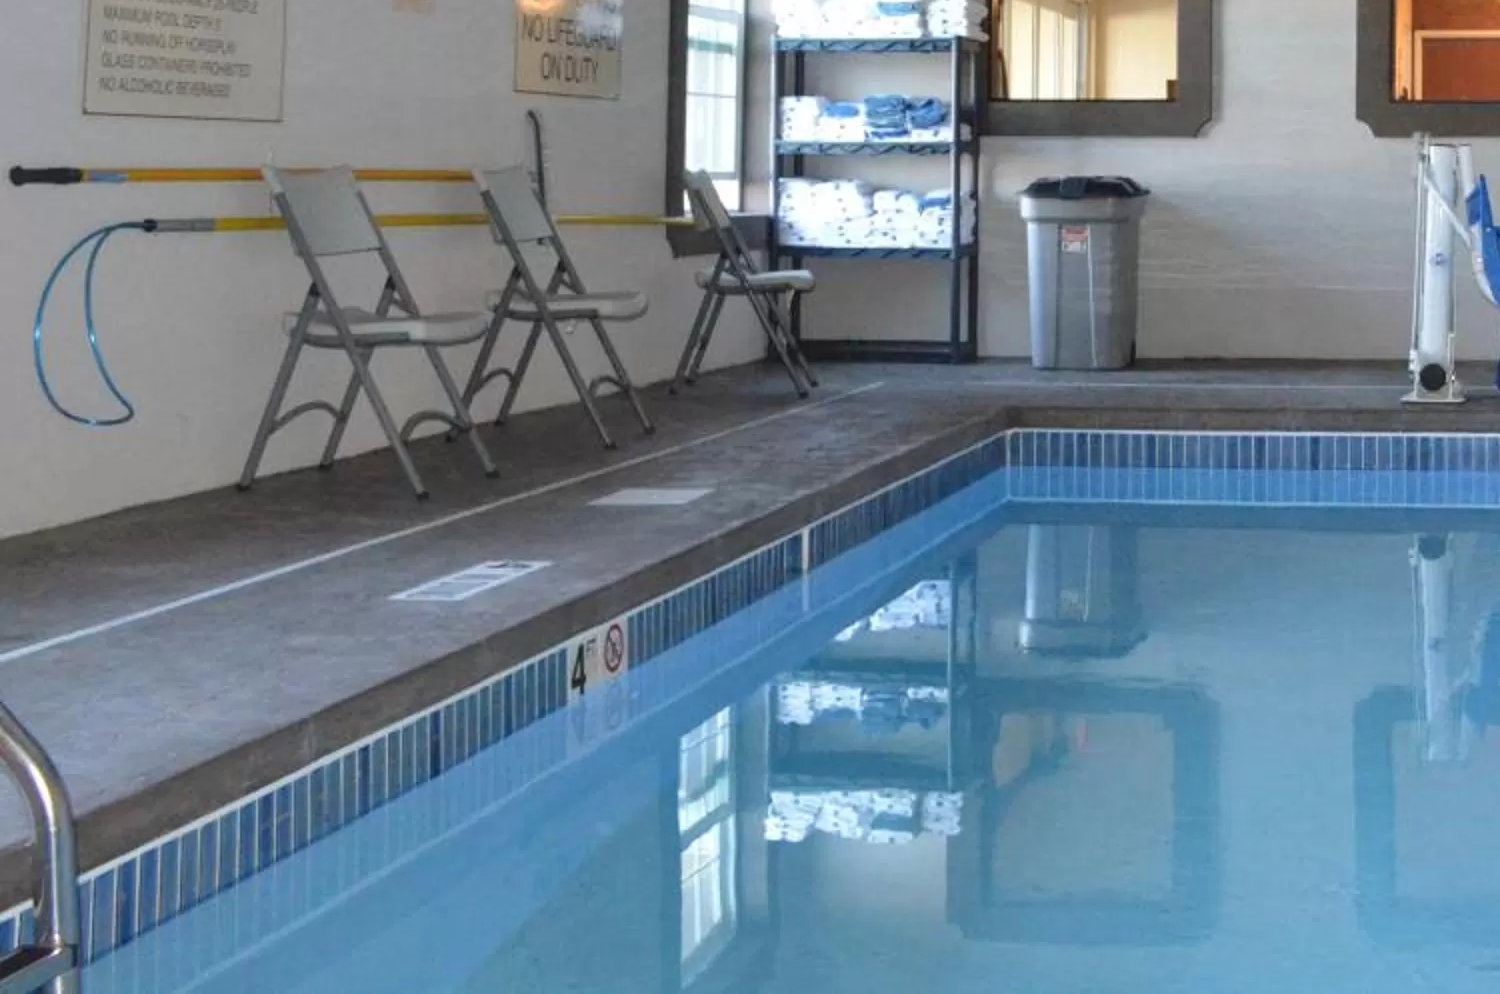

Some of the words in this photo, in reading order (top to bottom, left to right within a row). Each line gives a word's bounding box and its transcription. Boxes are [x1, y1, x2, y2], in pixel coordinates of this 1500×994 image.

[522, 13, 543, 42] NO
[541, 53, 561, 80] ON
[564, 55, 599, 83] DUTY
[571, 642, 587, 696] 4
